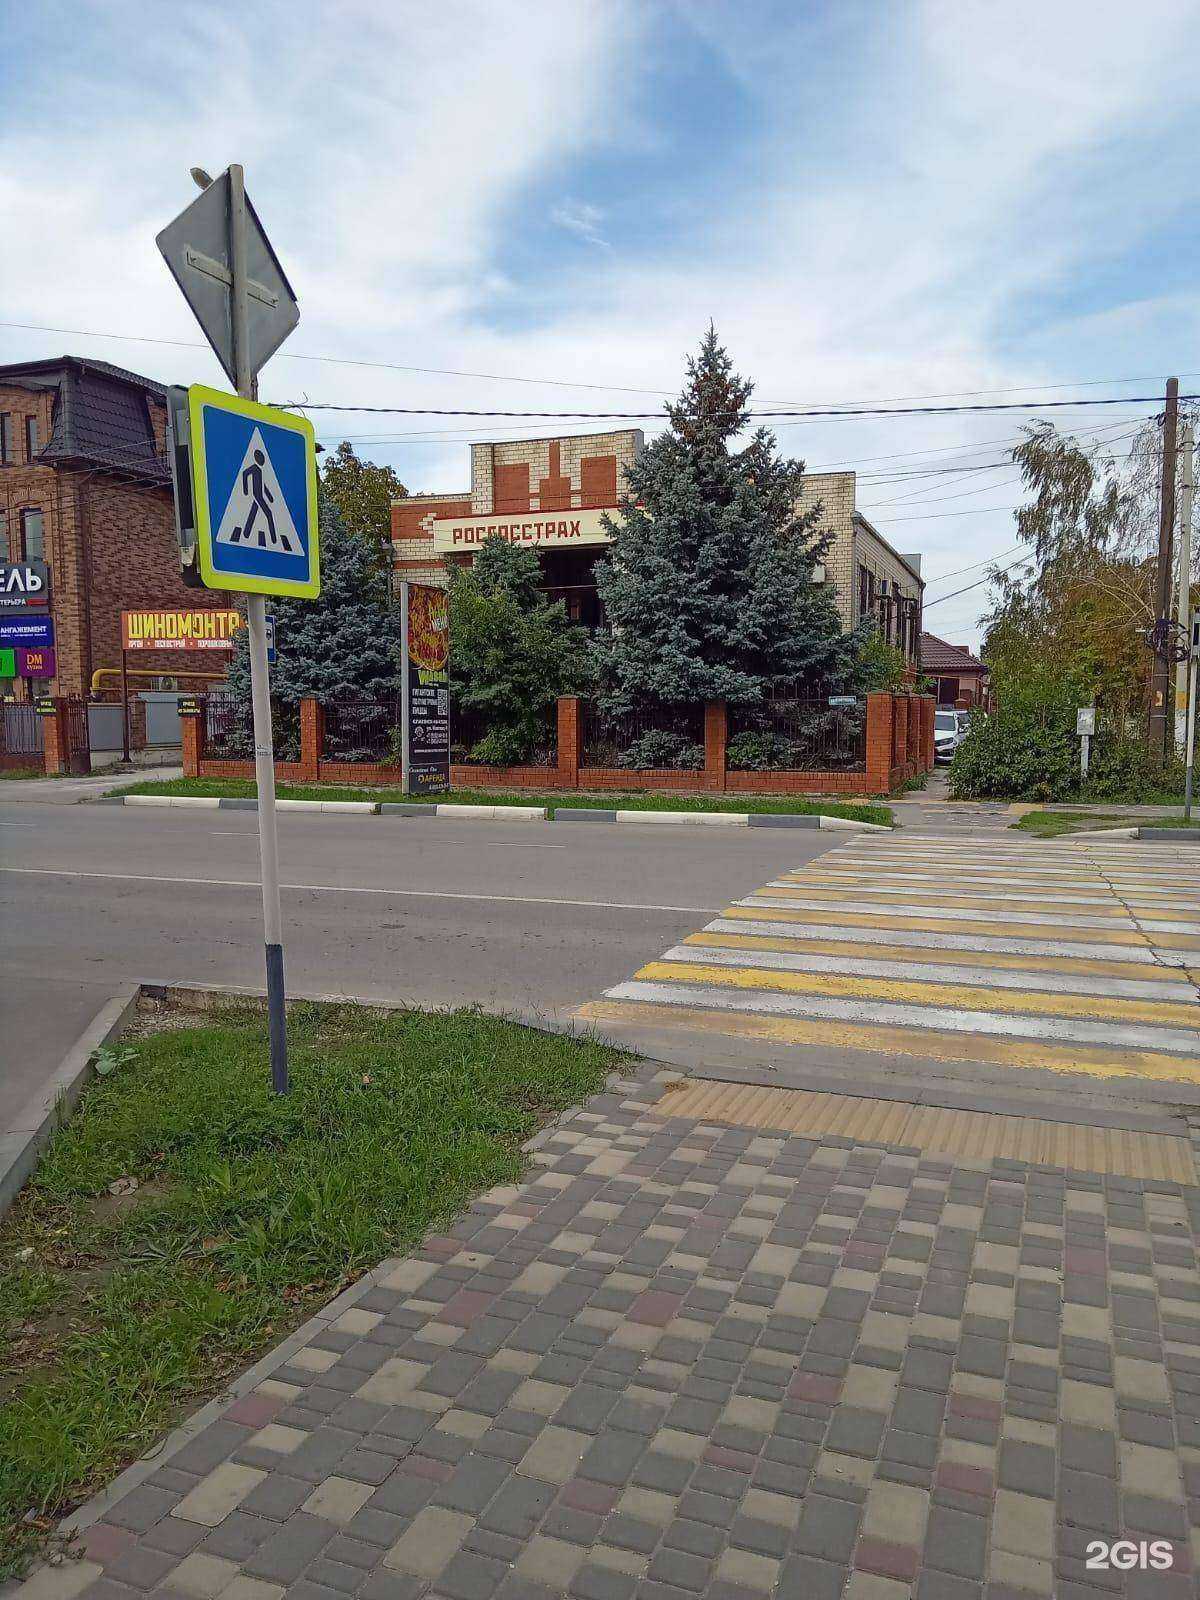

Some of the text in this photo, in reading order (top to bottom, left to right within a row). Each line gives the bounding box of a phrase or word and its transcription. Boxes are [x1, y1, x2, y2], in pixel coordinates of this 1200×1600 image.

[453, 520, 581, 544] РОСГОССТРАХ
[128, 612, 240, 639] ШИНОМОНТА
[26, 654, 43, 665] DM
